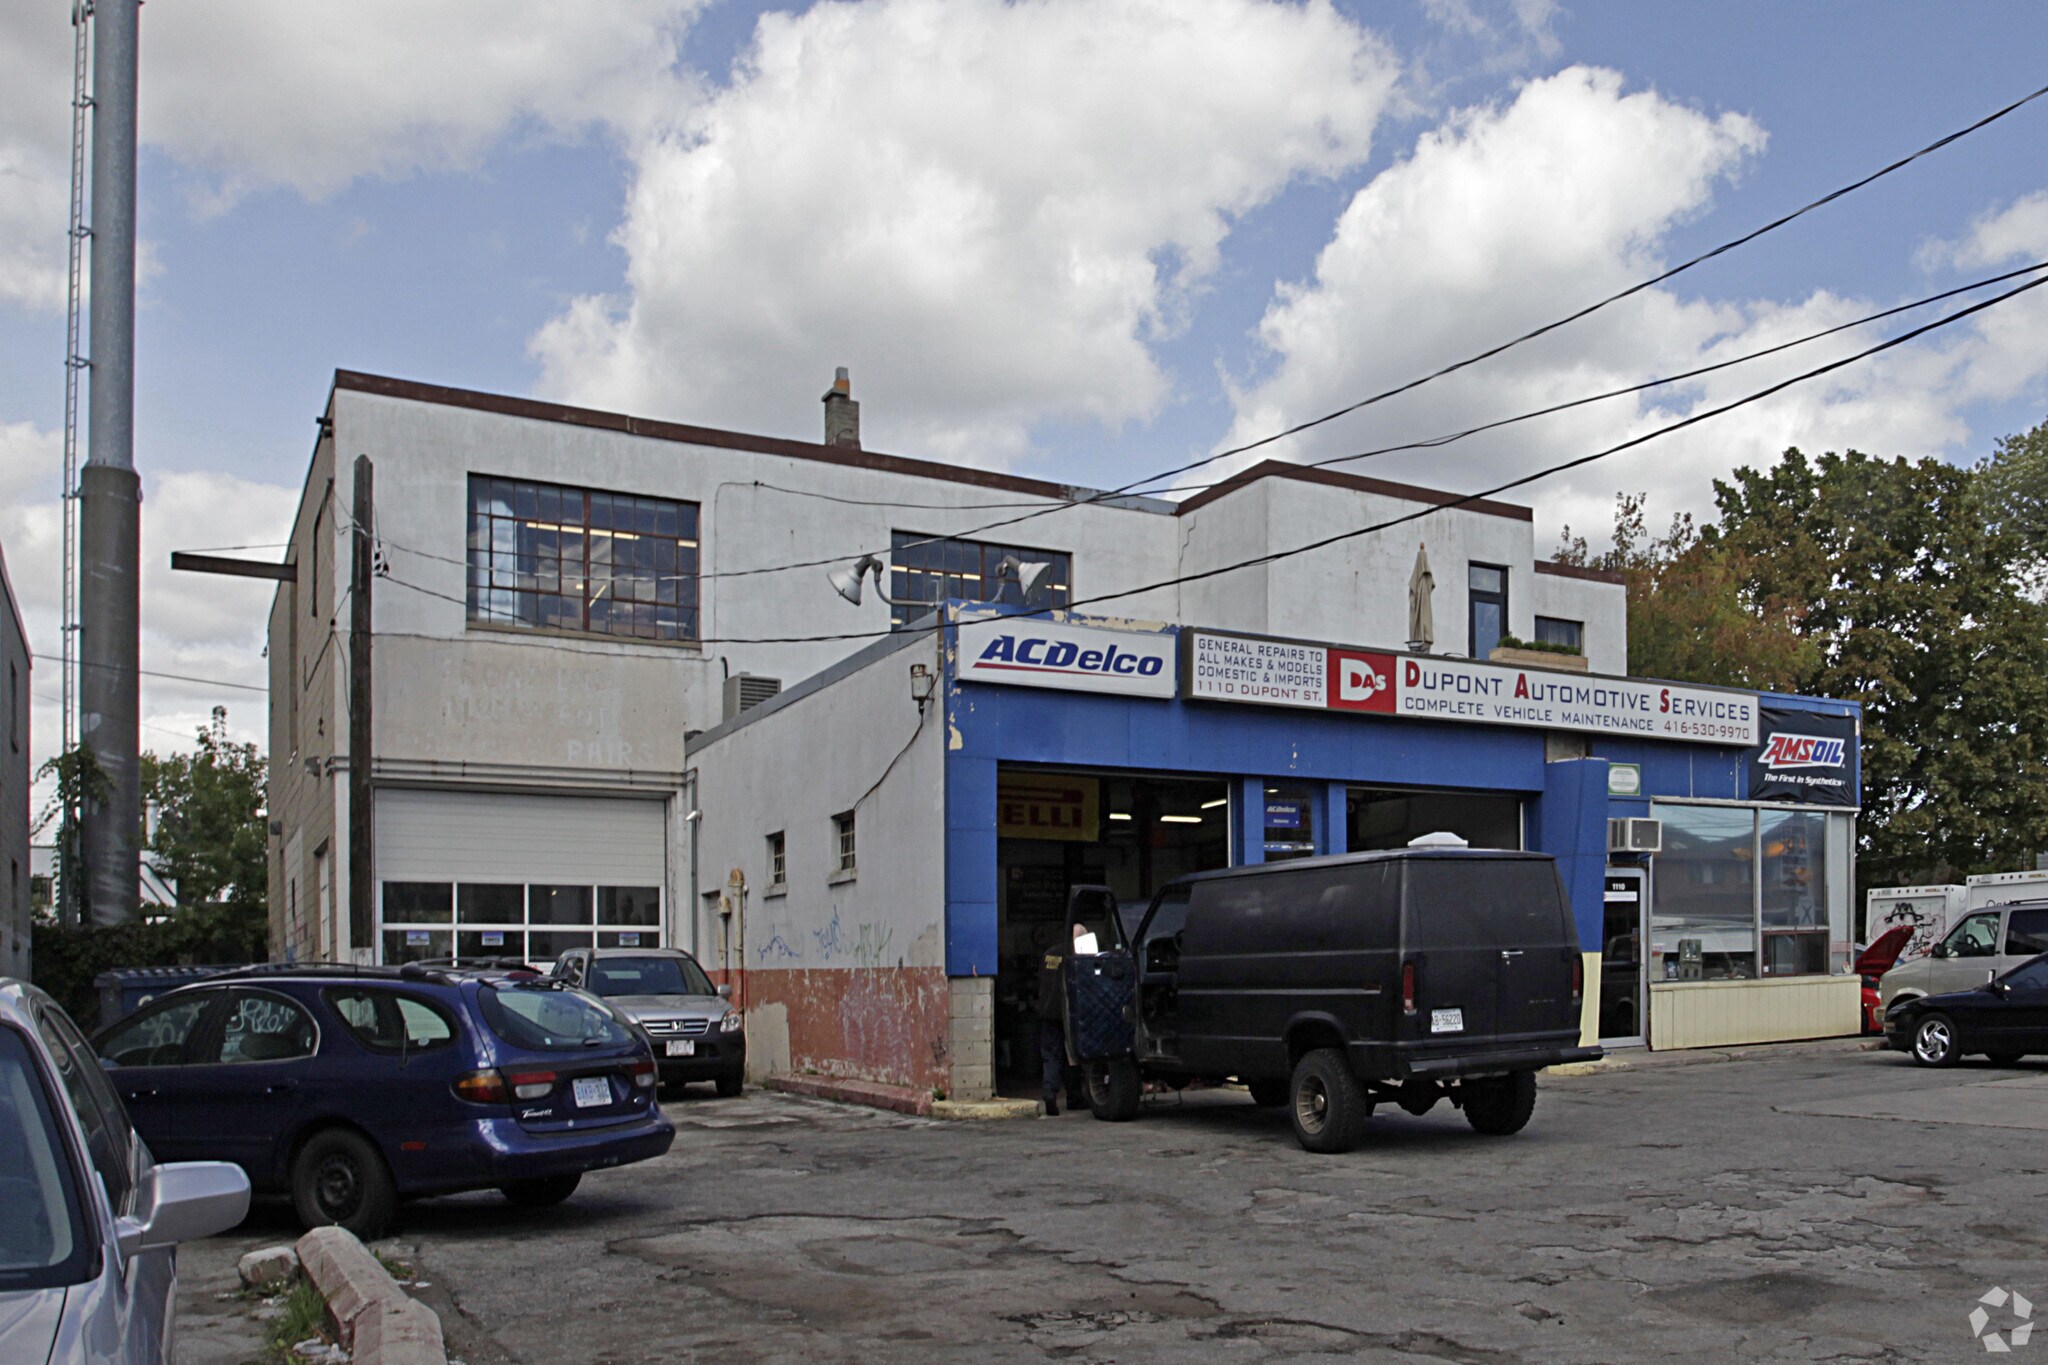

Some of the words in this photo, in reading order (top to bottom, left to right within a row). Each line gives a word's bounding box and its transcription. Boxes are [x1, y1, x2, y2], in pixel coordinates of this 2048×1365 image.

[979, 634, 1164, 676] ACDelco
[1199, 638, 1252, 655] GENERAL
[1258, 645, 1305, 661] REPAIRS
[1309, 651, 1322, 662] TO
[1199, 652, 1220, 664] ALL
[1224, 656, 1263, 669] MAKES
[1267, 660, 1274, 671] &
[1278, 661, 1323, 675] MODELS
[1199, 666, 1257, 682] DOMESTIC
[1263, 672, 1270, 683] &
[1275, 673, 1322, 688] IMPORTS
[1199, 680, 1235, 694] 1110
[1241, 684, 1298, 700] DUPONT
[1303, 691, 1322, 702] ST.
[1405, 660, 1502, 696] DUPONT
[1514, 673, 1650, 711] AUTOMOTIVE
[1659, 688, 1750, 721] SERVICES
[1405, 697, 1484, 716] COMPLETE
[1494, 705, 1552, 722] VEHICLE
[1562, 711, 1654, 731] MAINTENANCE
[1664, 720, 1750, 740] 416-530-9970
[1763, 735, 1842, 765] AMSOIL
[1764, 773, 1778, 782] The
[1779, 774, 1796, 783] First
[1797, 775, 1804, 783] in
[1805, 776, 1842, 786] Synthetics
[1004, 803, 1082, 828] ELLI
